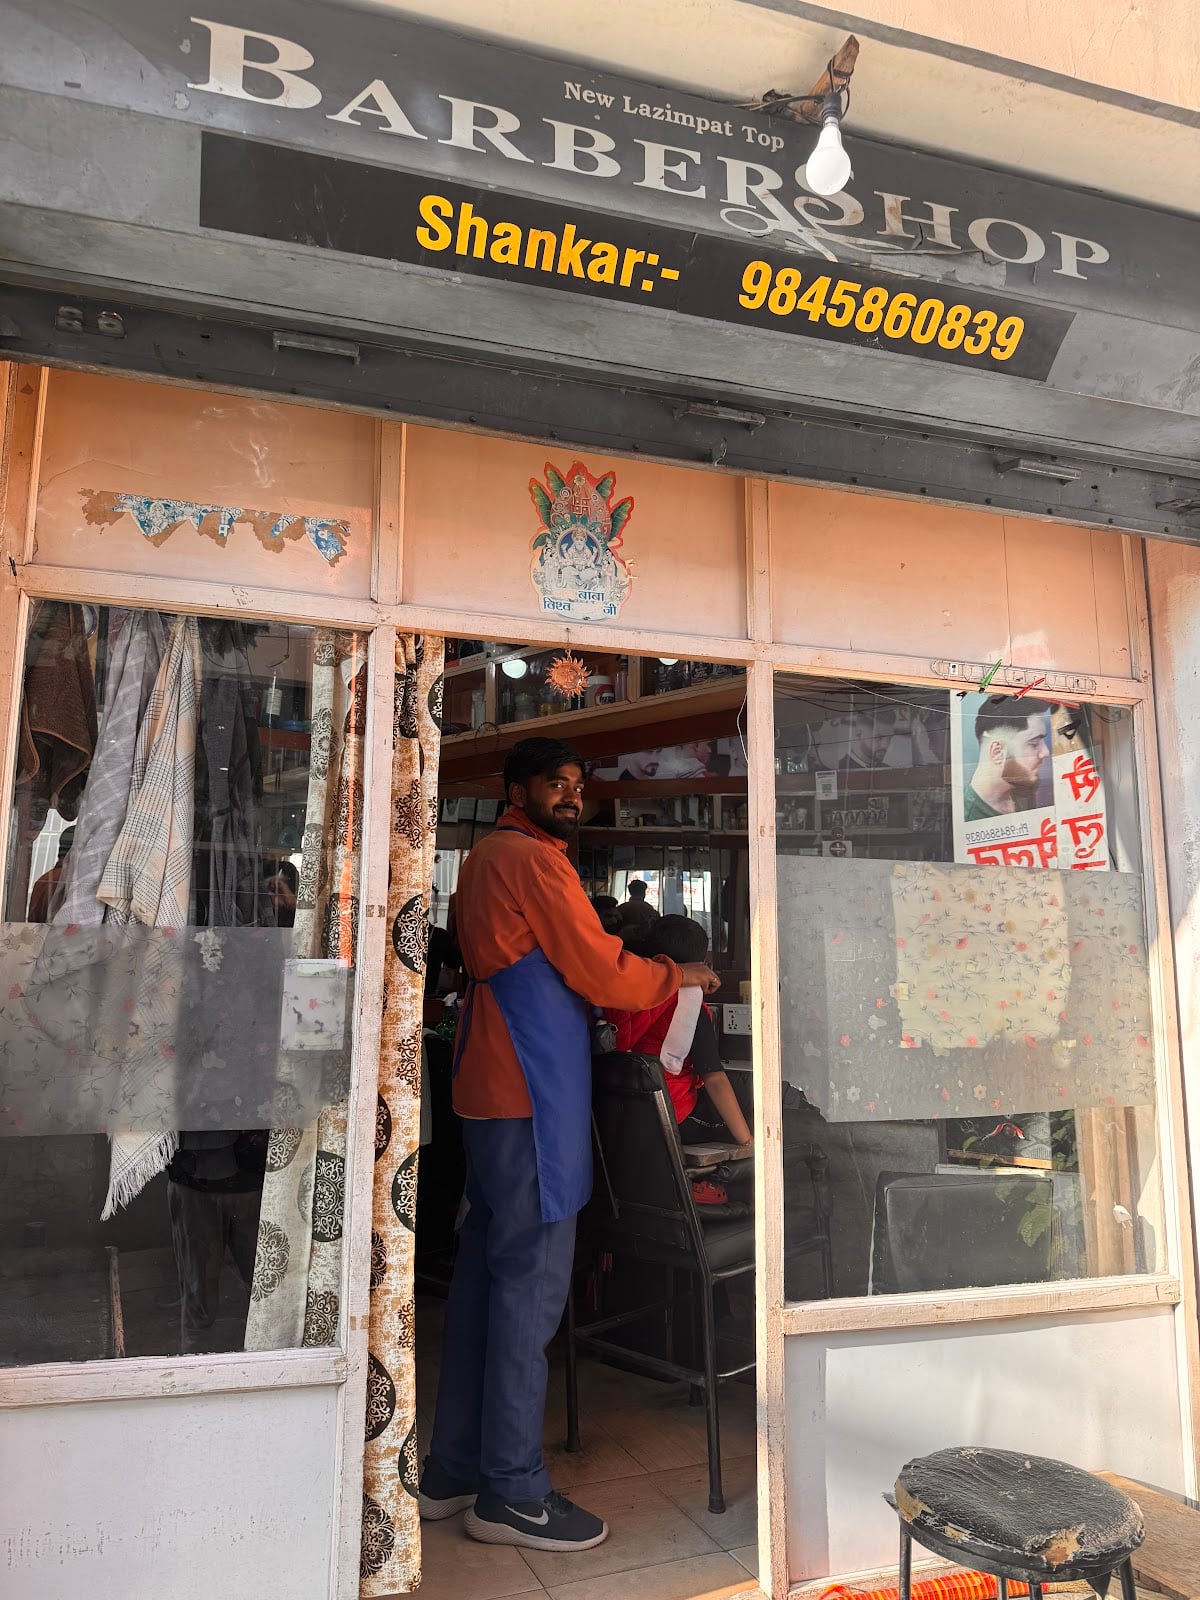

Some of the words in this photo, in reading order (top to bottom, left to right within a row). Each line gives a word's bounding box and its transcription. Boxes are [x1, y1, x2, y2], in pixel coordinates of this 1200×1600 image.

[564, 81, 615, 108] New
[623, 95, 733, 136] Lazimpat
[742, 125, 784, 152] Top
[416, 195, 680, 292] Shankar:-
[738, 261, 1025, 360] 9845860839
